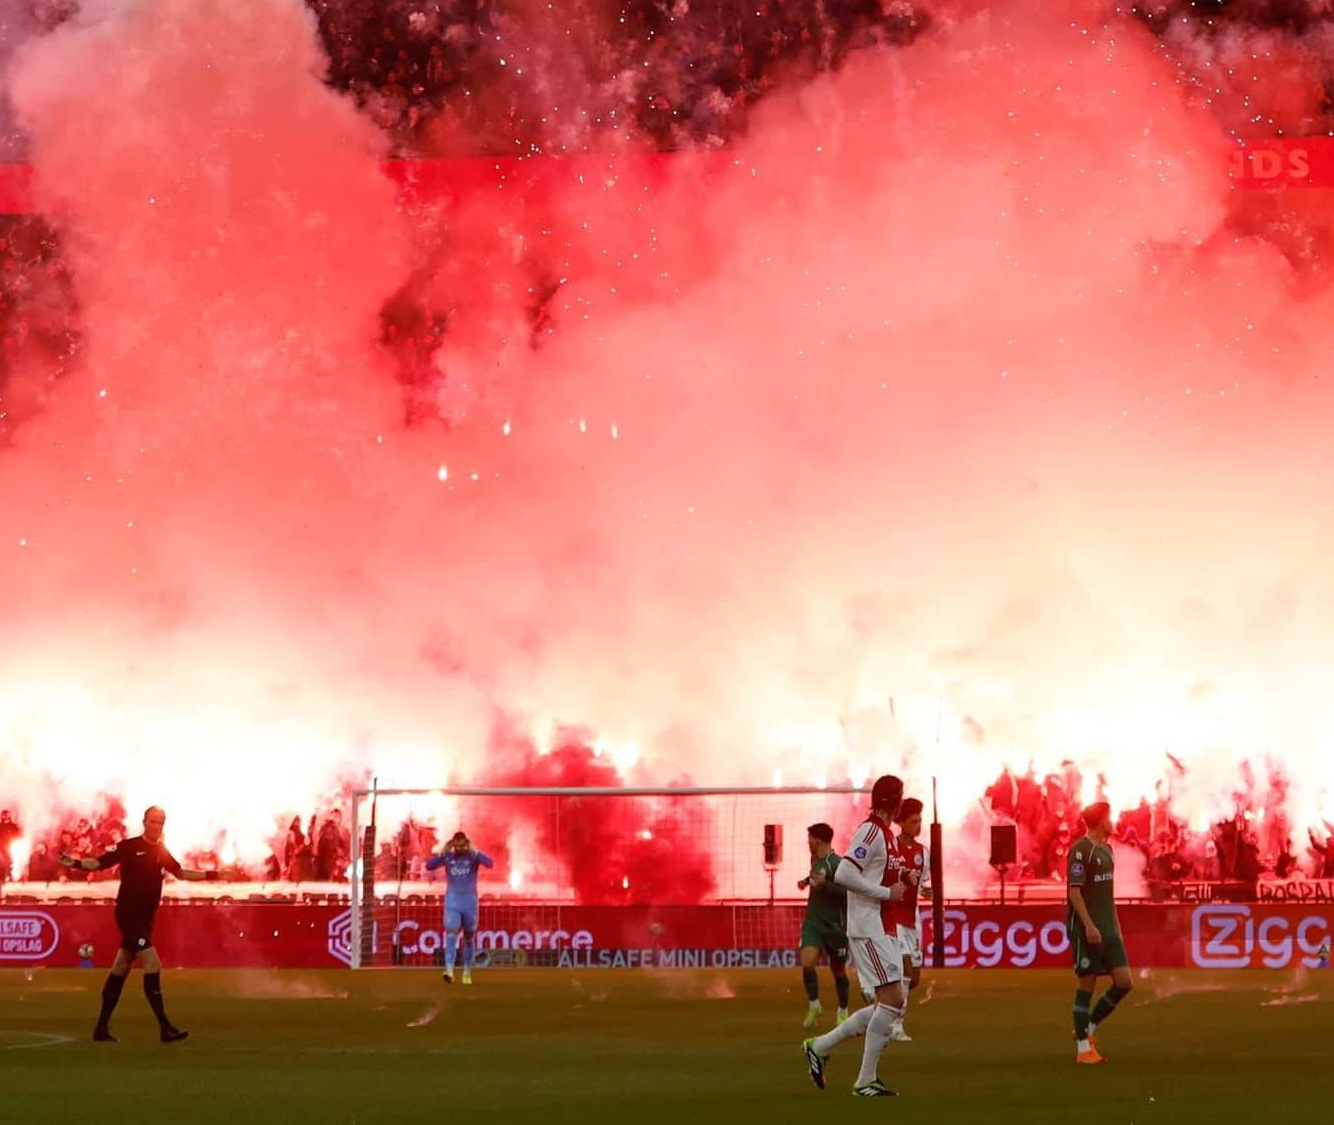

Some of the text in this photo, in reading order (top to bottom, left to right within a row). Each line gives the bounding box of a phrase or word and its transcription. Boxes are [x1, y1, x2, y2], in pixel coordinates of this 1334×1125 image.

[557, 949, 796, 968] ALLSAFE MINI OPSLAG
